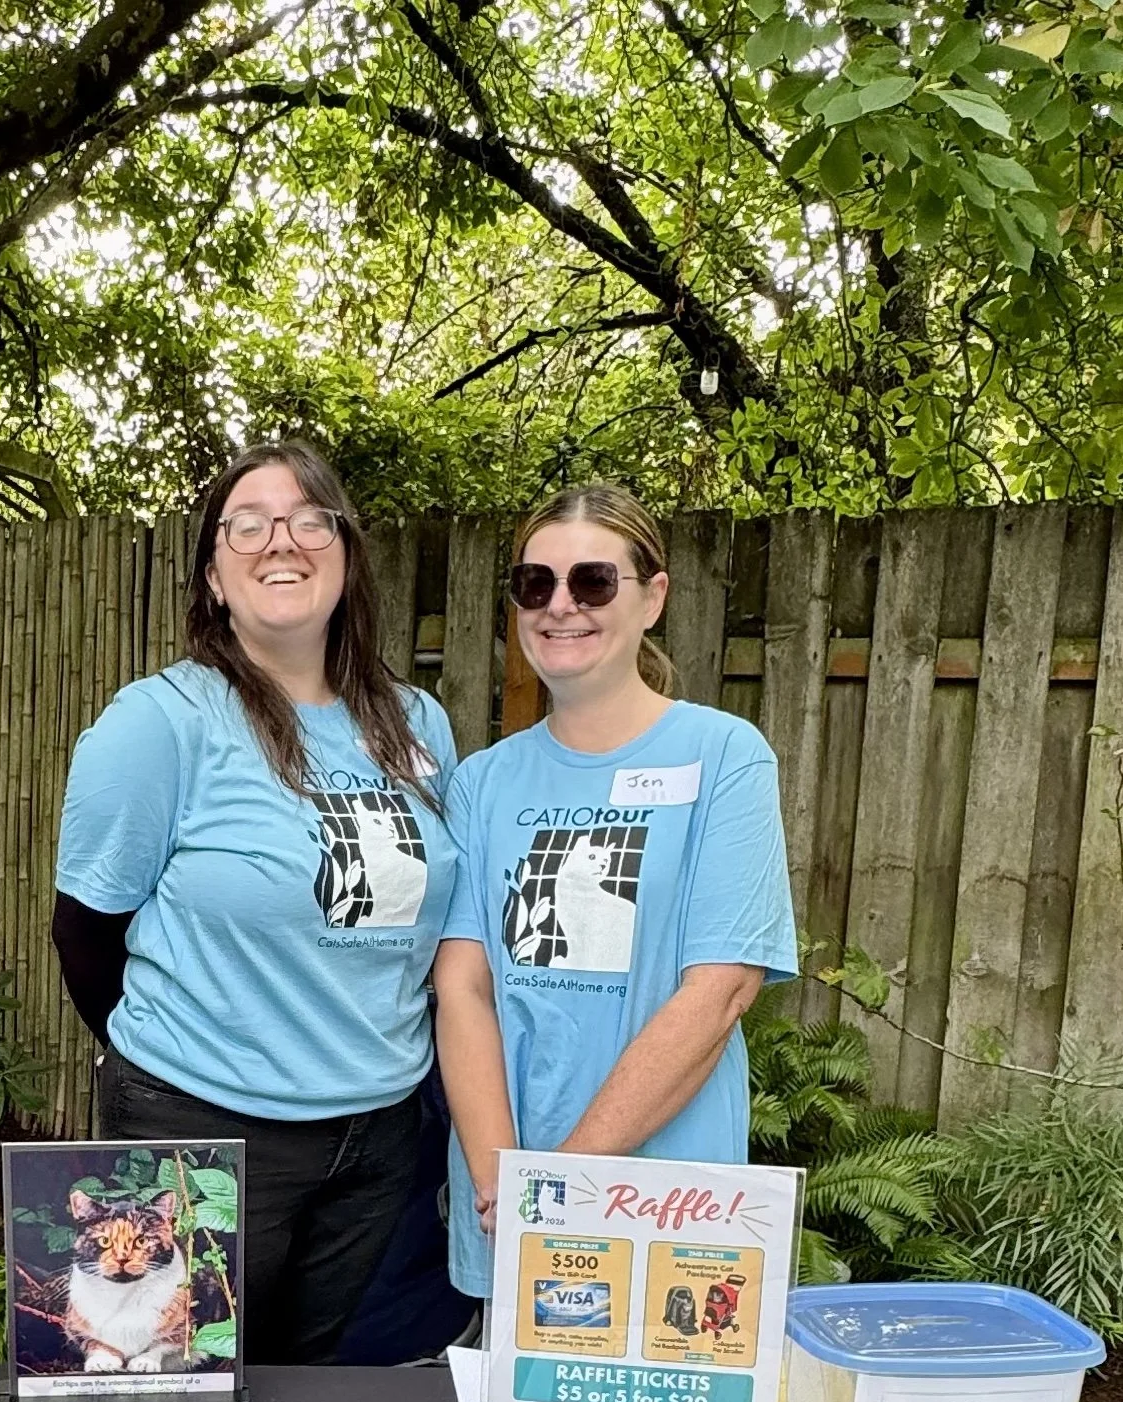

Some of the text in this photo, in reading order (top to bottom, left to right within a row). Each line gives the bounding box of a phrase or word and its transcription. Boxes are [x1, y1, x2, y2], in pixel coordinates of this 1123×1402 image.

[626, 773, 664, 789] Jen
[516, 806, 654, 827] CATIOtour
[505, 973, 628, 997] CatsSafeAtHome.org
[604, 1184, 745, 1231] Raffle!
[551, 1252, 598, 1270] $500
[555, 1291, 595, 1306] VISA
[556, 1364, 711, 1392] RAFFLE TICKETS
[557, 1383, 583, 1402] $5
